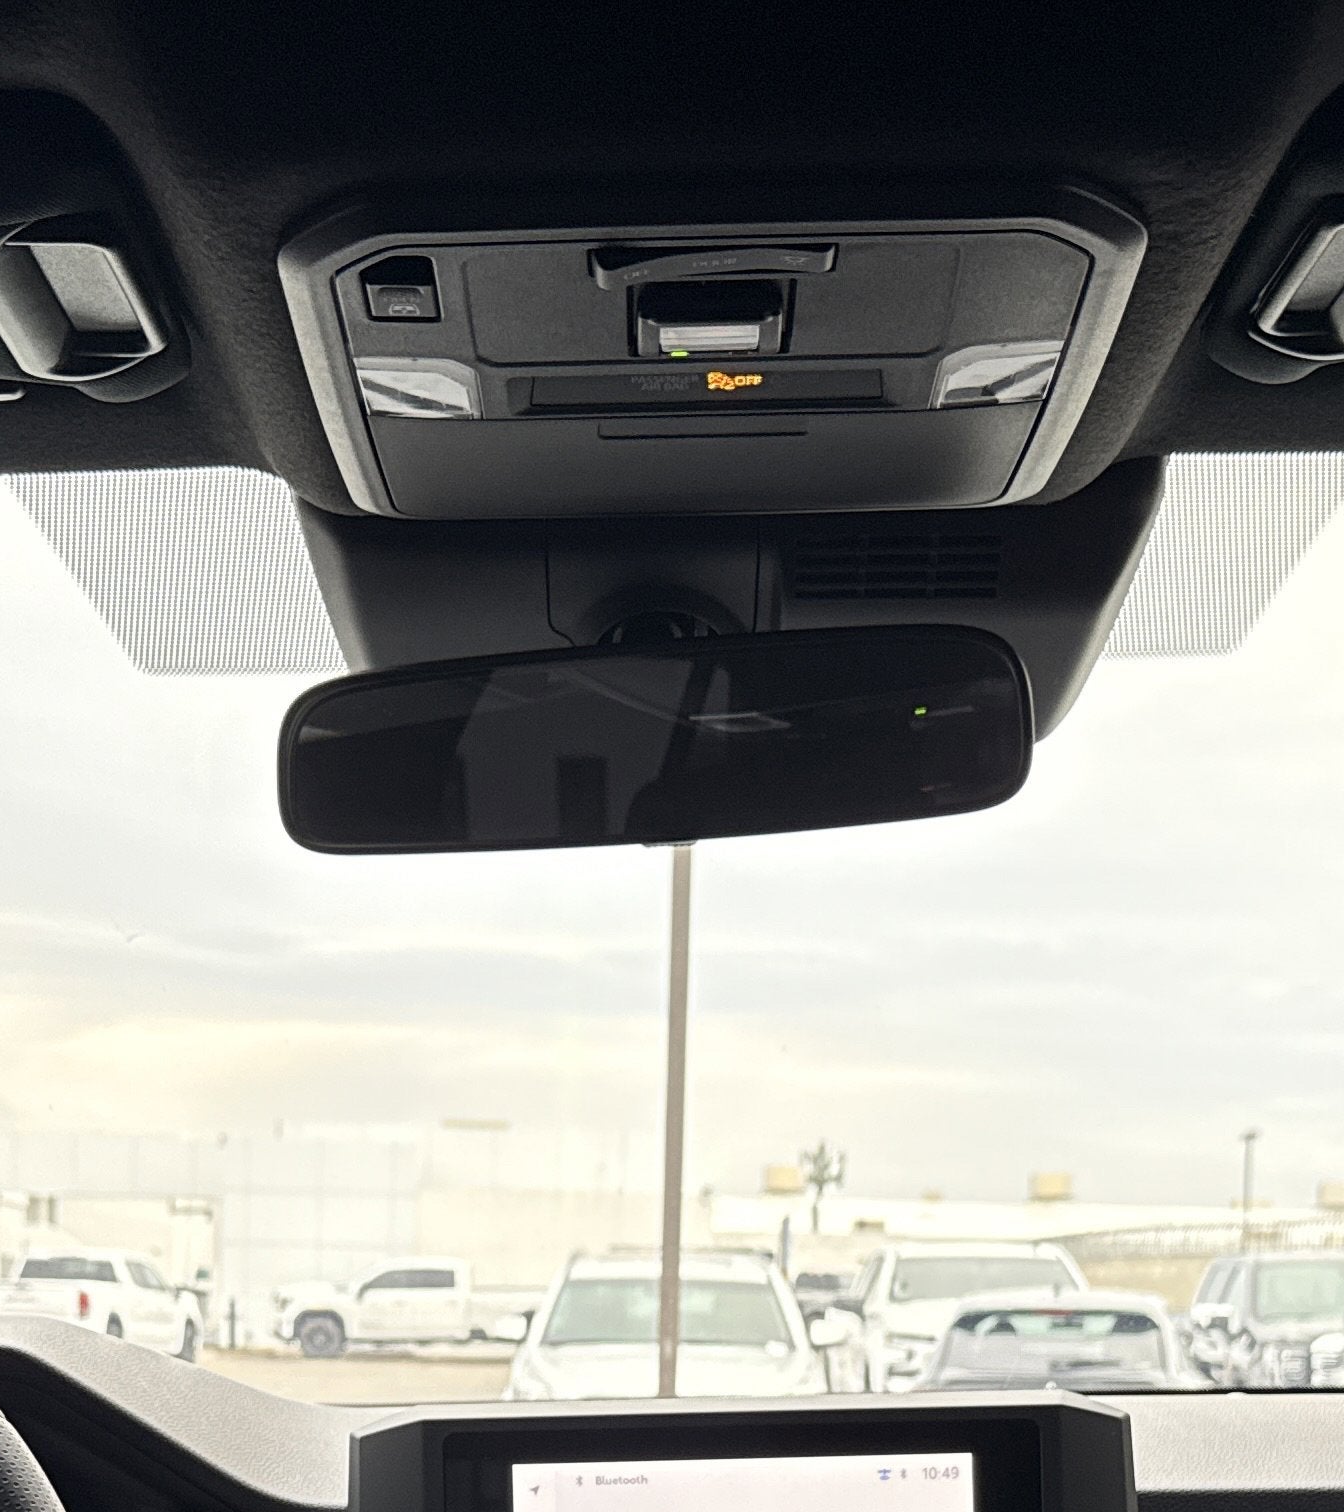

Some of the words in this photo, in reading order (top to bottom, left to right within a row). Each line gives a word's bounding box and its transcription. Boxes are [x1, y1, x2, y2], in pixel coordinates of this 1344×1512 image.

[735, 374, 763, 386] OFF
[594, 1472, 649, 1487] Bluetooth
[921, 1466, 960, 1481] 10:49
